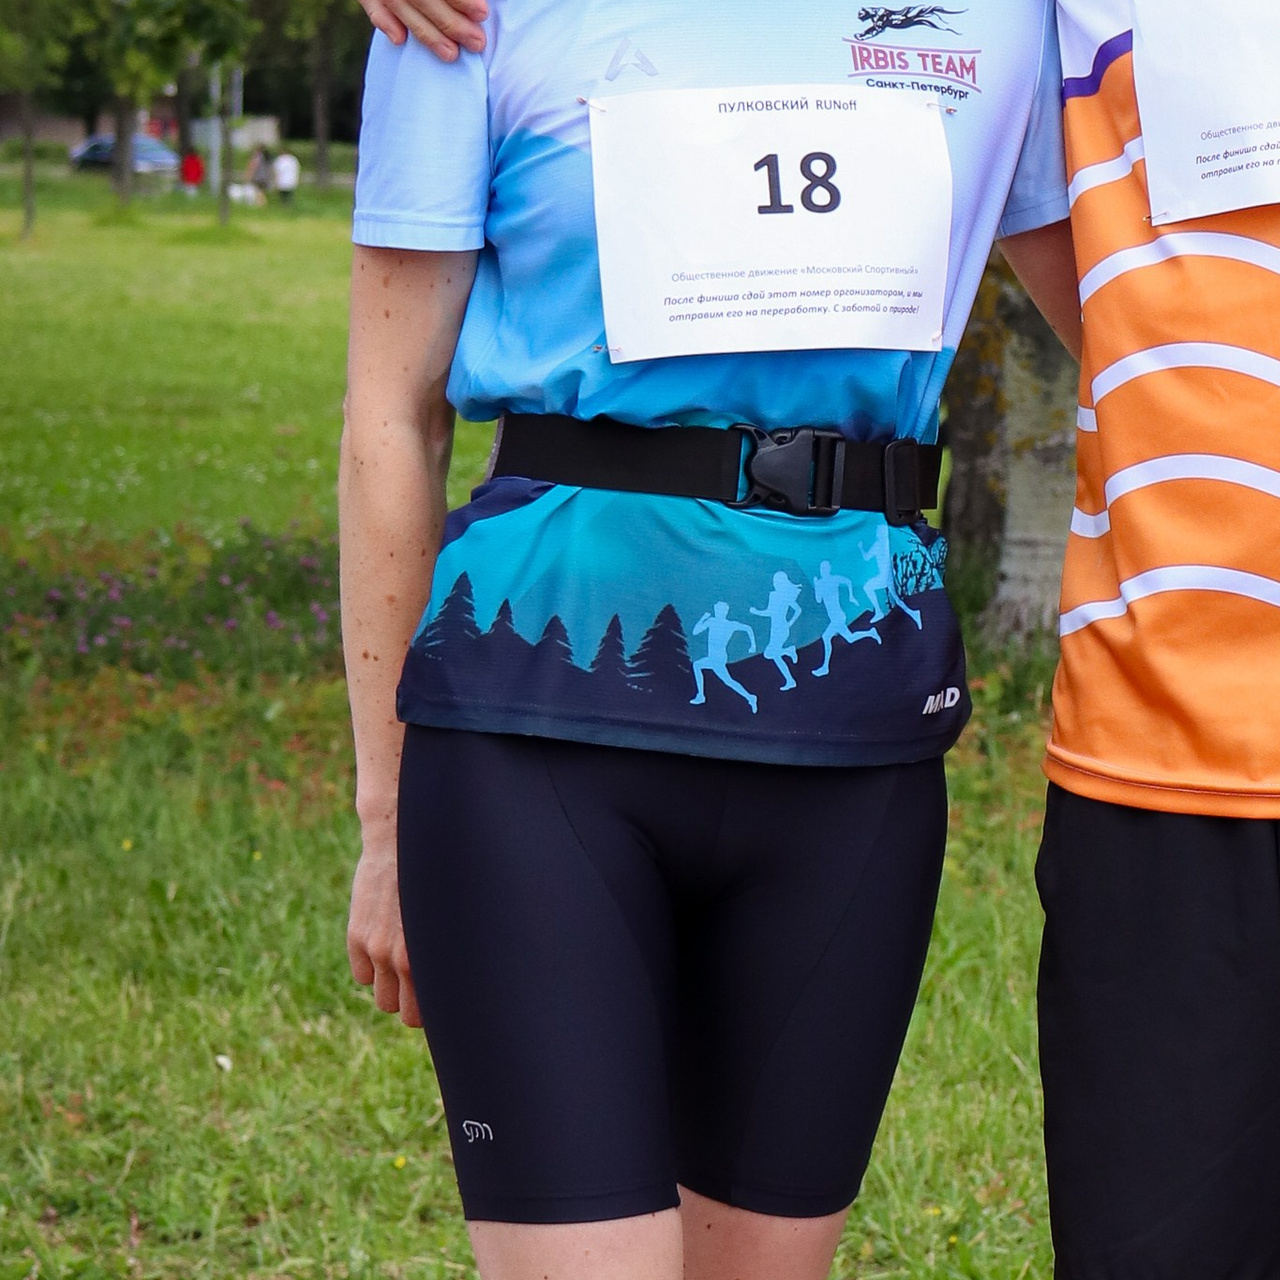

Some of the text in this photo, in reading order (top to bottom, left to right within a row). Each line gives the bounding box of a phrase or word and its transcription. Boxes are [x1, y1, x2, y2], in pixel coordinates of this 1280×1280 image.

[850, 44, 978, 86] IRBIS TEAM
[865, 77, 970, 101] Санкт-Петербург
[717, 96, 858, 114] ПУЛКОВСКИЙ RUNoff
[1200, 122, 1264, 141] Общественное
[1195, 153, 1221, 165] После
[1222, 144, 1258, 160] финиша
[1201, 164, 1244, 180] отправим
[1245, 160, 1260, 170] его
[1262, 159, 1274, 167] на
[753, 151, 842, 215] 18
[671, 270, 746, 283] Общественное
[747, 267, 798, 279] движение
[800, 264, 863, 275] «Московский
[663, 295, 695, 306] После
[697, 293, 740, 305] финиша
[741, 290, 766, 300] сдай
[767, 290, 798, 299] этот
[800, 288, 831, 298] номер
[668, 310, 724, 322] отправим
[726, 309, 743, 318] его
[745, 308, 758, 317] на
[760, 305, 831, 318] переработку.
[833, 303, 840, 313] С
[841, 302, 882, 313] заботой
